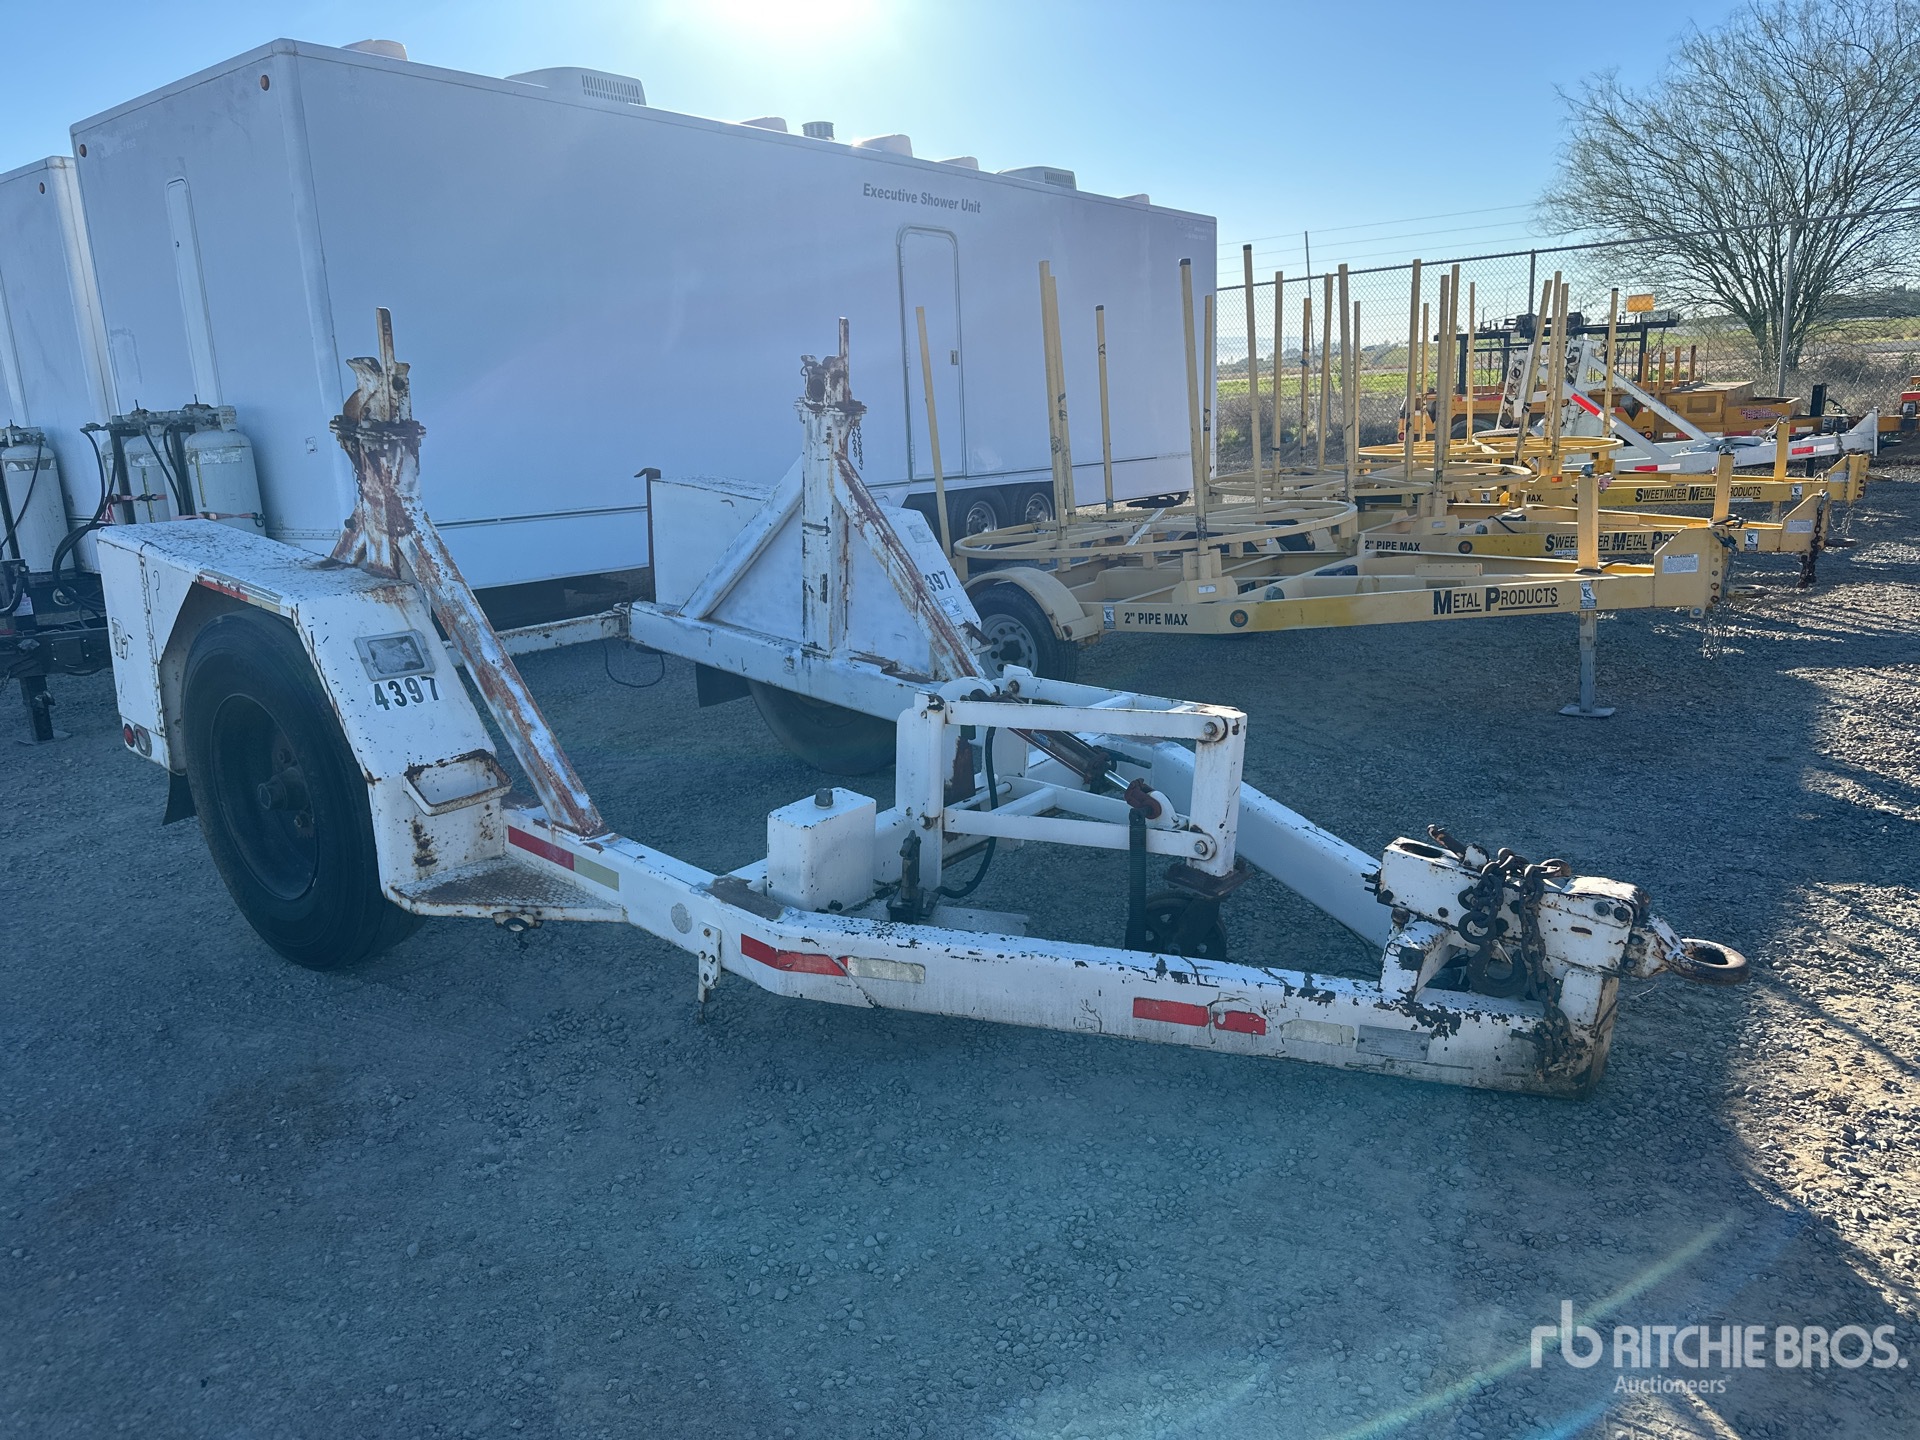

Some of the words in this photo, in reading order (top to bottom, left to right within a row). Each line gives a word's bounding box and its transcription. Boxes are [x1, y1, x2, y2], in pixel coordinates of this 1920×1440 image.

[863, 182, 917, 203] Executive
[920, 192, 958, 210] Shower
[961, 198, 981, 213] Unit
[1730, 486, 1761, 497] RODUCTS
[1376, 541, 1397, 550] PIPE
[1399, 542, 1421, 551] MAX
[1612, 532, 1647, 551] METAL
[924, 570, 952, 592] 397
[1433, 590, 1481, 615] METAL
[1485, 587, 1558, 611] PRODUCTS
[1138, 612, 1161, 625] PIPE
[1164, 613, 1188, 626] MAX
[373, 675, 439, 711] 4397
